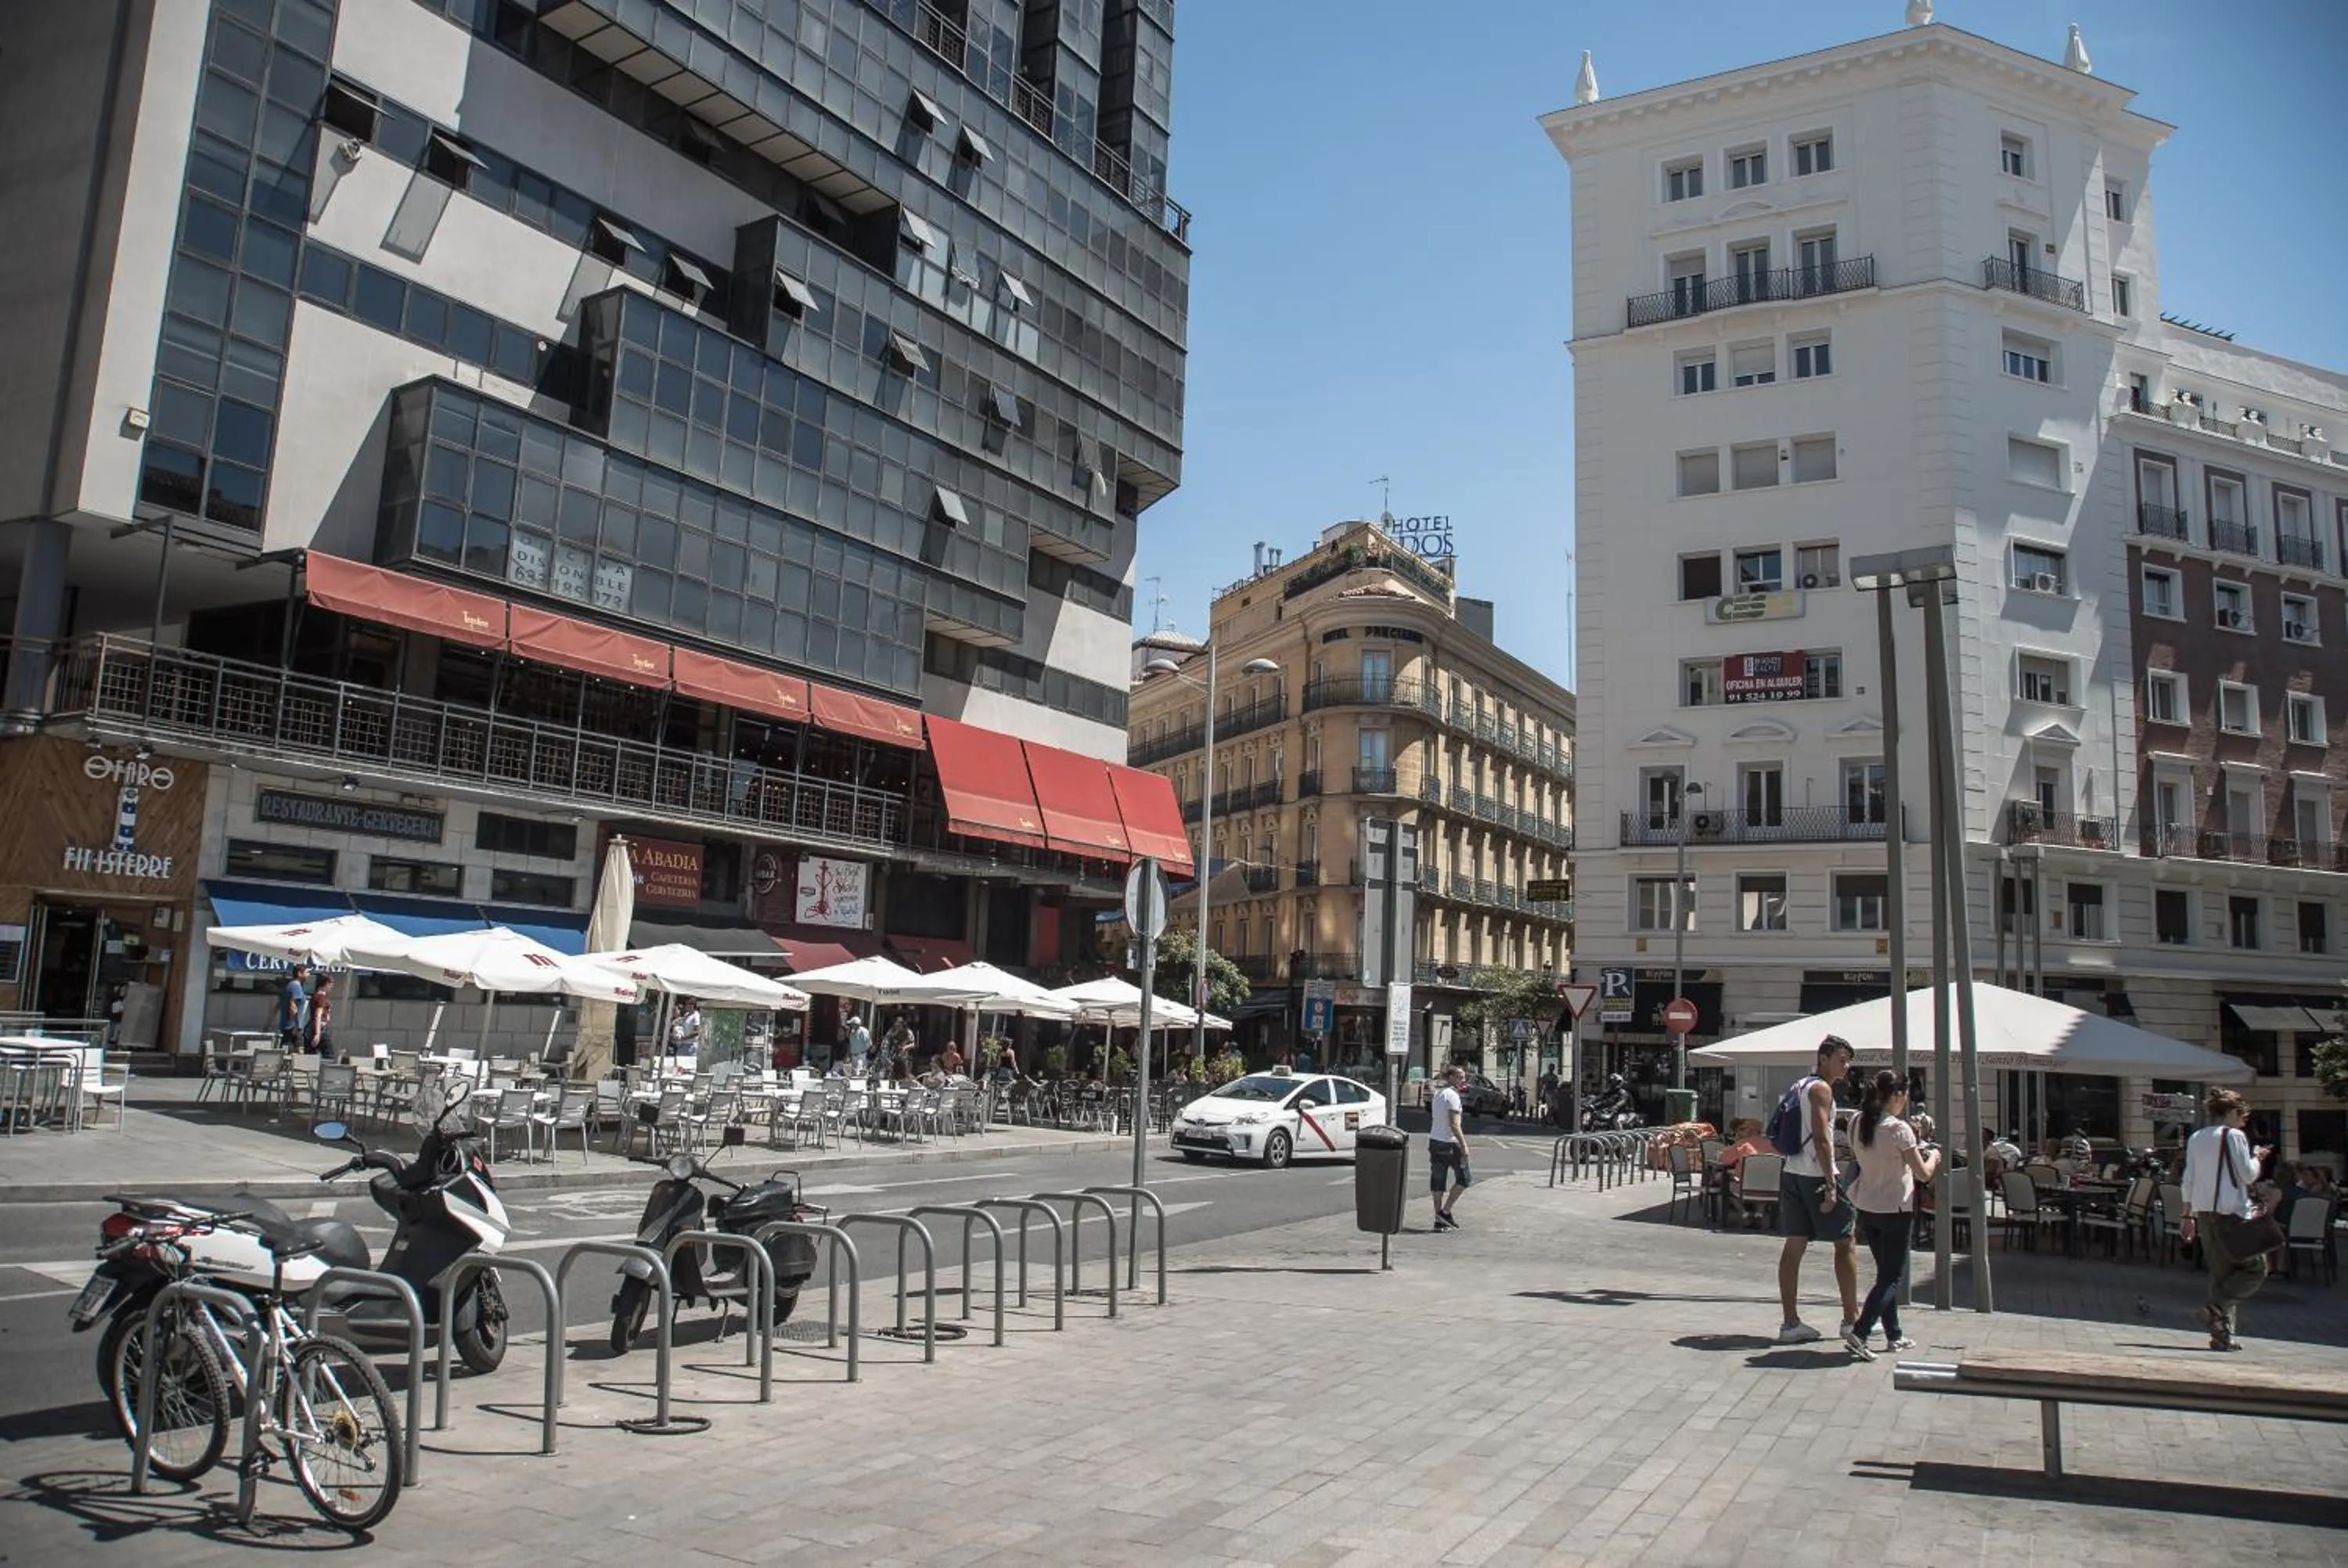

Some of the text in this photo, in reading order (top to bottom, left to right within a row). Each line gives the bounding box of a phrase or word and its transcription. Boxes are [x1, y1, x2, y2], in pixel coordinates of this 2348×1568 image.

[1392, 516, 1453, 534] HOTEL
[520, 532, 625, 576] OFCINA
[517, 550, 626, 592] DISONBLE
[1726, 676, 1802, 690] OFICINA EN ALQUILER
[641, 847, 699, 871] ABADIA
